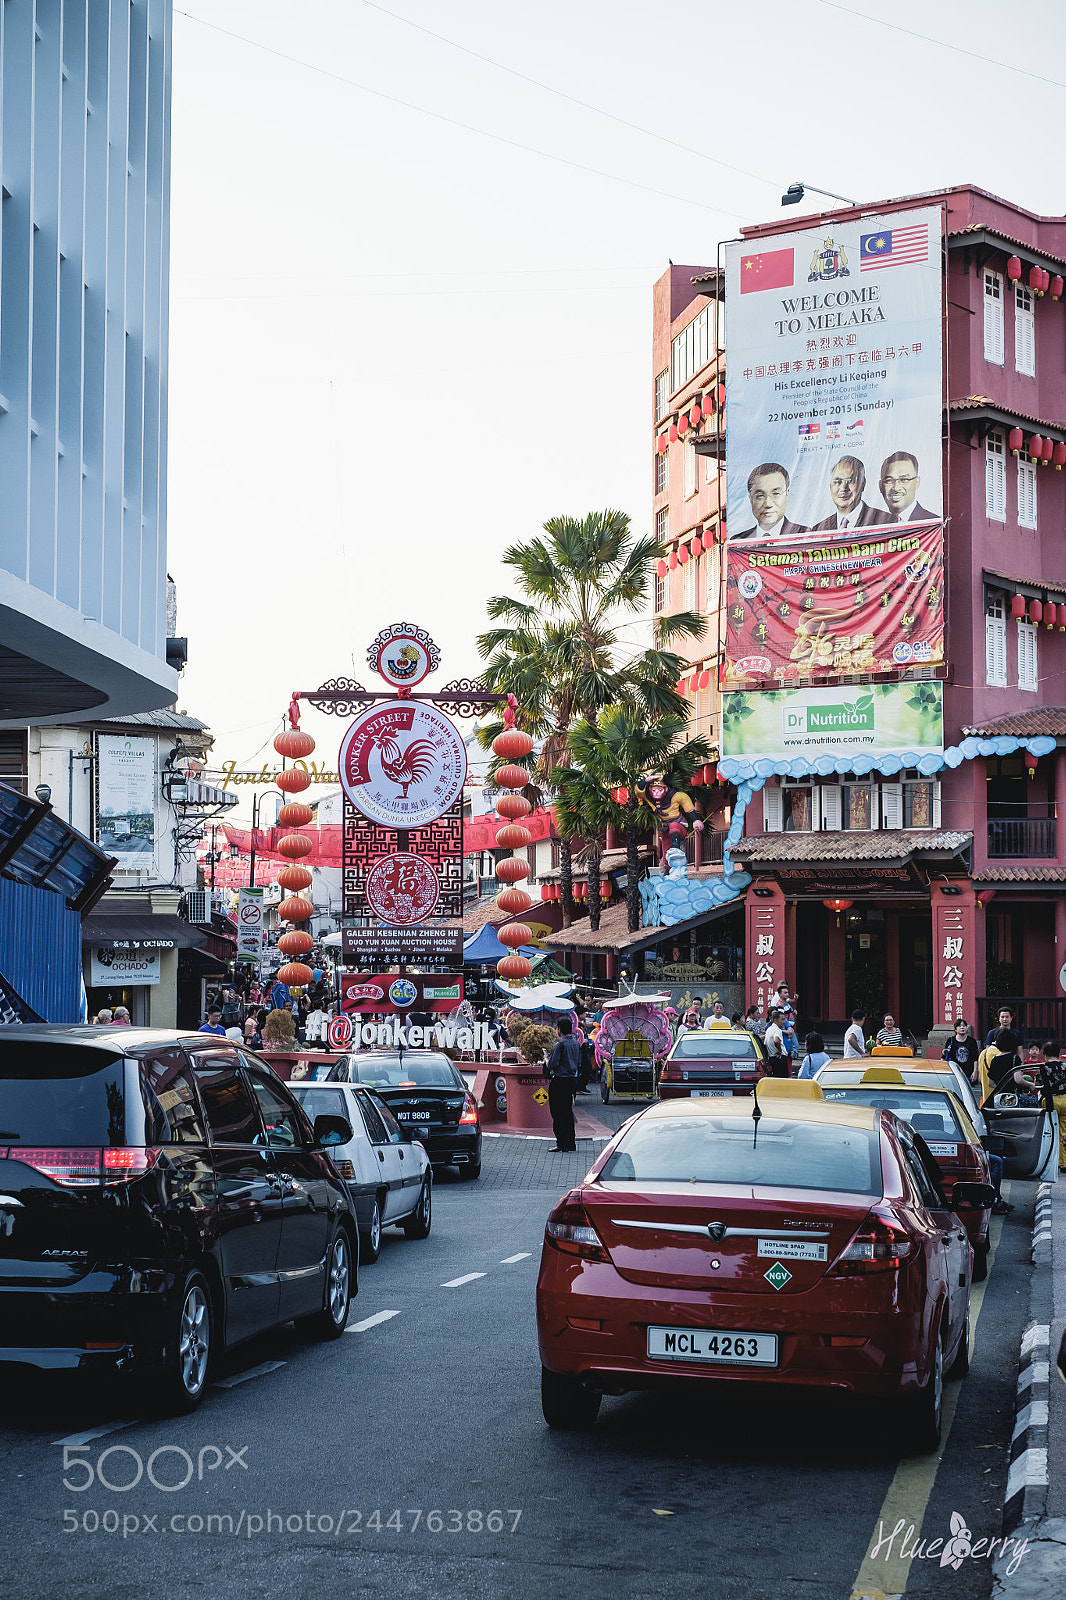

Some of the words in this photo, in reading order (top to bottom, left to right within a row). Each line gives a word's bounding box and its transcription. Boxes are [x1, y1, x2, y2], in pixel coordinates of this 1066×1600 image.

[781, 285, 880, 314] WELCOME
[775, 319, 801, 336] TO
[807, 306, 886, 332] MELAKA
[806, 333, 857, 352] 热烈欢迎
[774, 382, 788, 391] His
[791, 376, 837, 389] Excellency
[840, 373, 848, 383] Li
[850, 369, 887, 381] Keqiang
[812, 389, 823, 397] the
[839, 384, 861, 393] Council
[851, 391, 868, 399] China
[768, 408, 779, 422] 22
[781, 407, 828, 421] November
[830, 405, 852, 415] 2015
[854, 398, 894, 413] (Sunday)
[748, 550, 804, 568] Selamat
[806, 545, 849, 563] Tahun
[850, 541, 885, 558] Baru
[887, 537, 920, 553] Cina
[784, 565, 808, 577] HAPPY
[809, 561, 840, 574] CHINESE
[842, 560, 860, 570] NEW
[861, 557, 882, 568] YEAR
[419, 711, 453, 738] HERITAGE
[788, 714, 803, 727] Dr
[810, 712, 868, 726] Nutrition
[350, 732, 369, 782] JONKER
[366, 712, 410, 734] STREET
[783, 736, 875, 746] www.drnutrition.com.my
[450, 738, 462, 779] CULTURAL
[438, 781, 458, 808] WORLD
[356, 789, 381, 818] WARISAN
[381, 812, 406, 823] DUNIA
[406, 809, 437, 823] UNESCO
[778, 868, 818, 879] San
[817, 868, 855, 878] Shu
[853, 867, 911, 881] Gong
[143, 940, 174, 948] OCHADO
[755, 907, 775, 983] 三叔公
[942, 908, 964, 988] 三叔公
[112, 962, 148, 971] OCHADO
[392, 988, 412, 998] G.L.
[412, 1112, 430, 1120] 9808
[784, 1219, 834, 1228] Persona
[41, 1249, 89, 1257] AERAS
[769, 1272, 788, 1280] NGV
[665, 1332, 701, 1354] MCL
[708, 1336, 758, 1357] 4263
